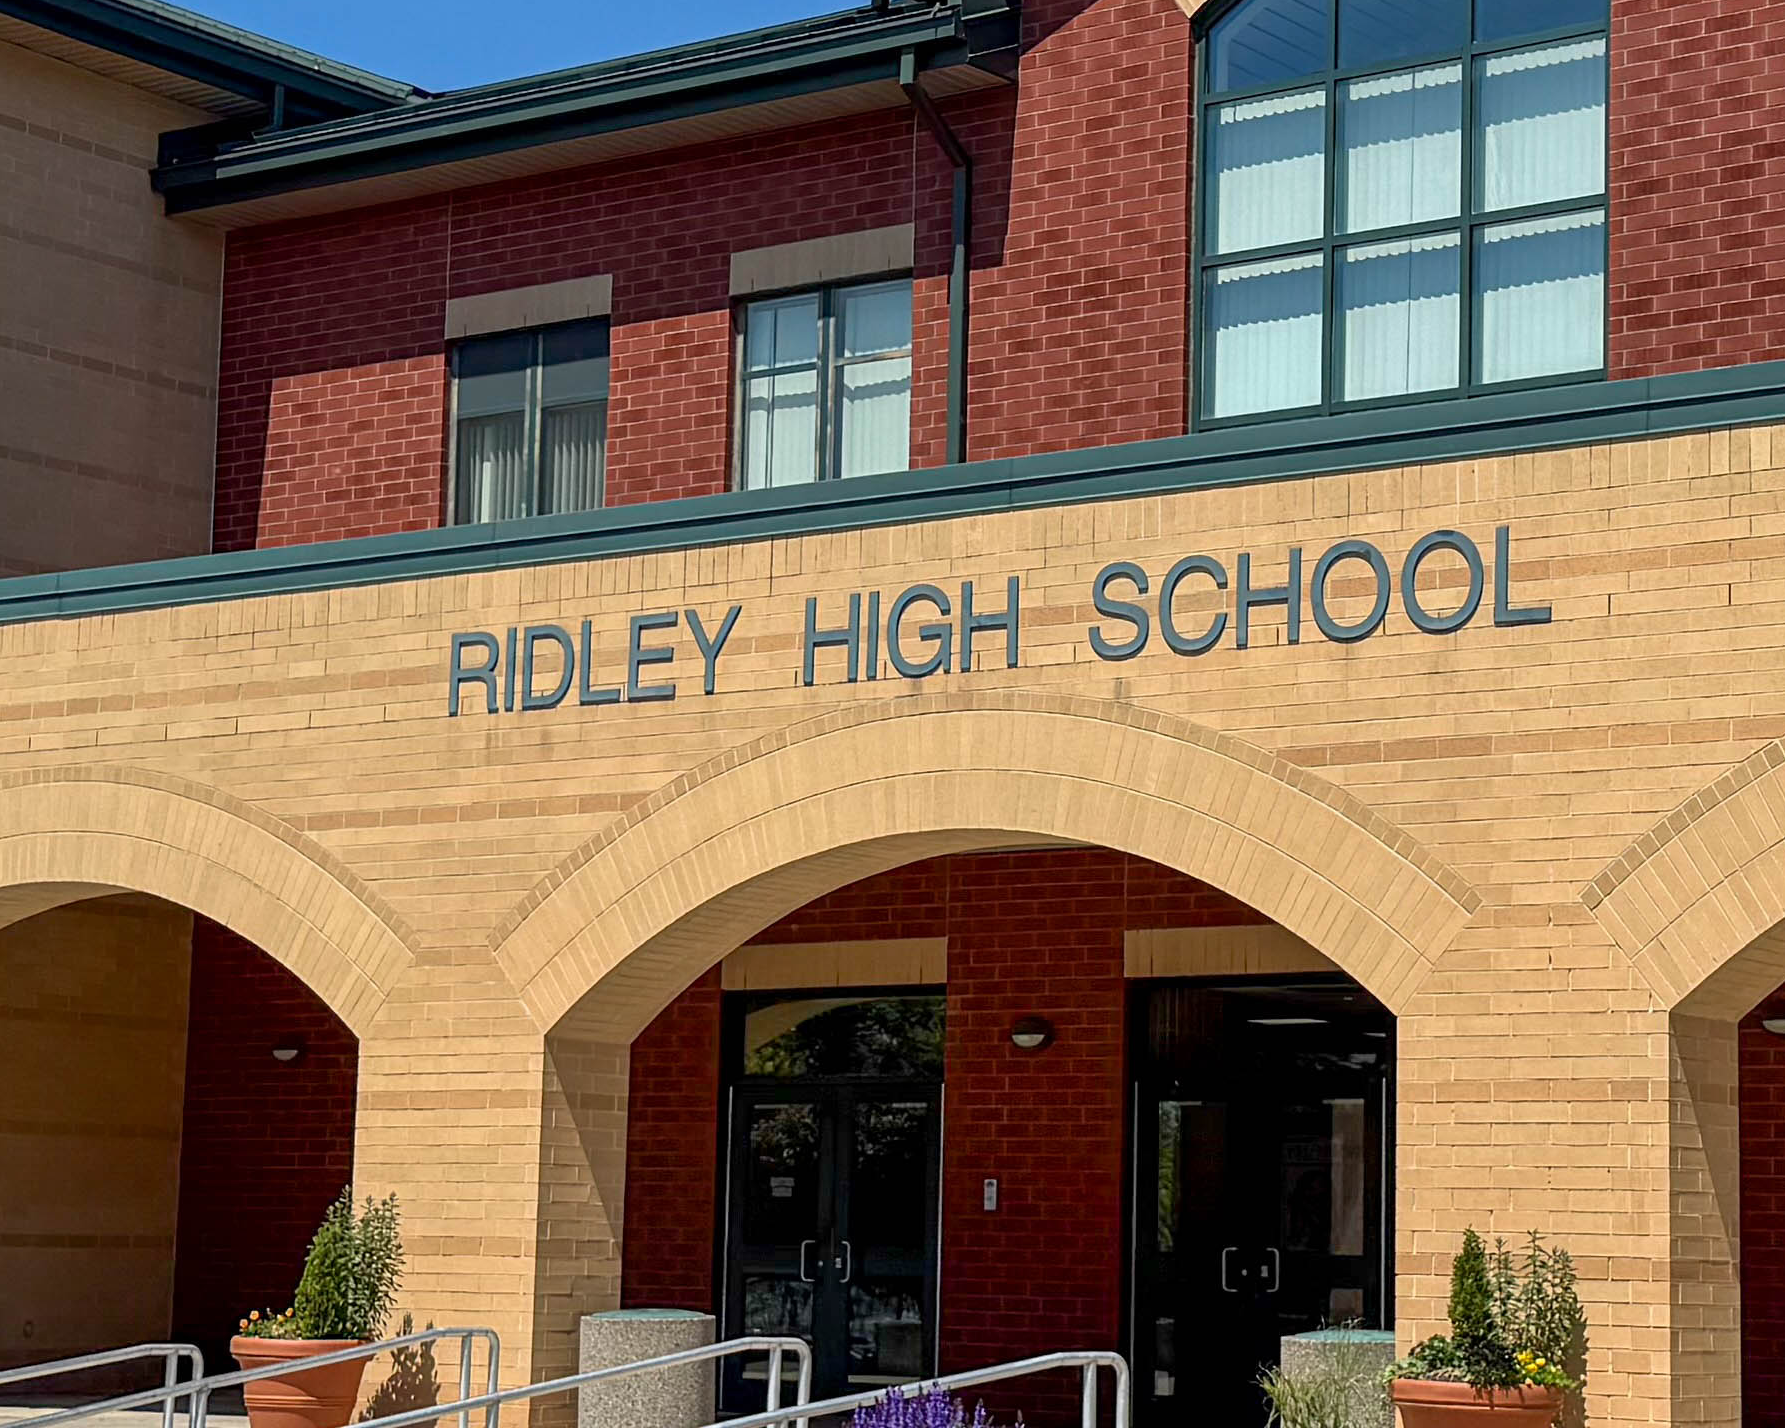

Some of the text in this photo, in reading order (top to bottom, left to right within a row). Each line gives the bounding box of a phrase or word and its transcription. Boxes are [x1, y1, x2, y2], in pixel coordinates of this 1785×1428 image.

[448, 525, 1552, 717] RIDLEY HIGH SCHOOL
